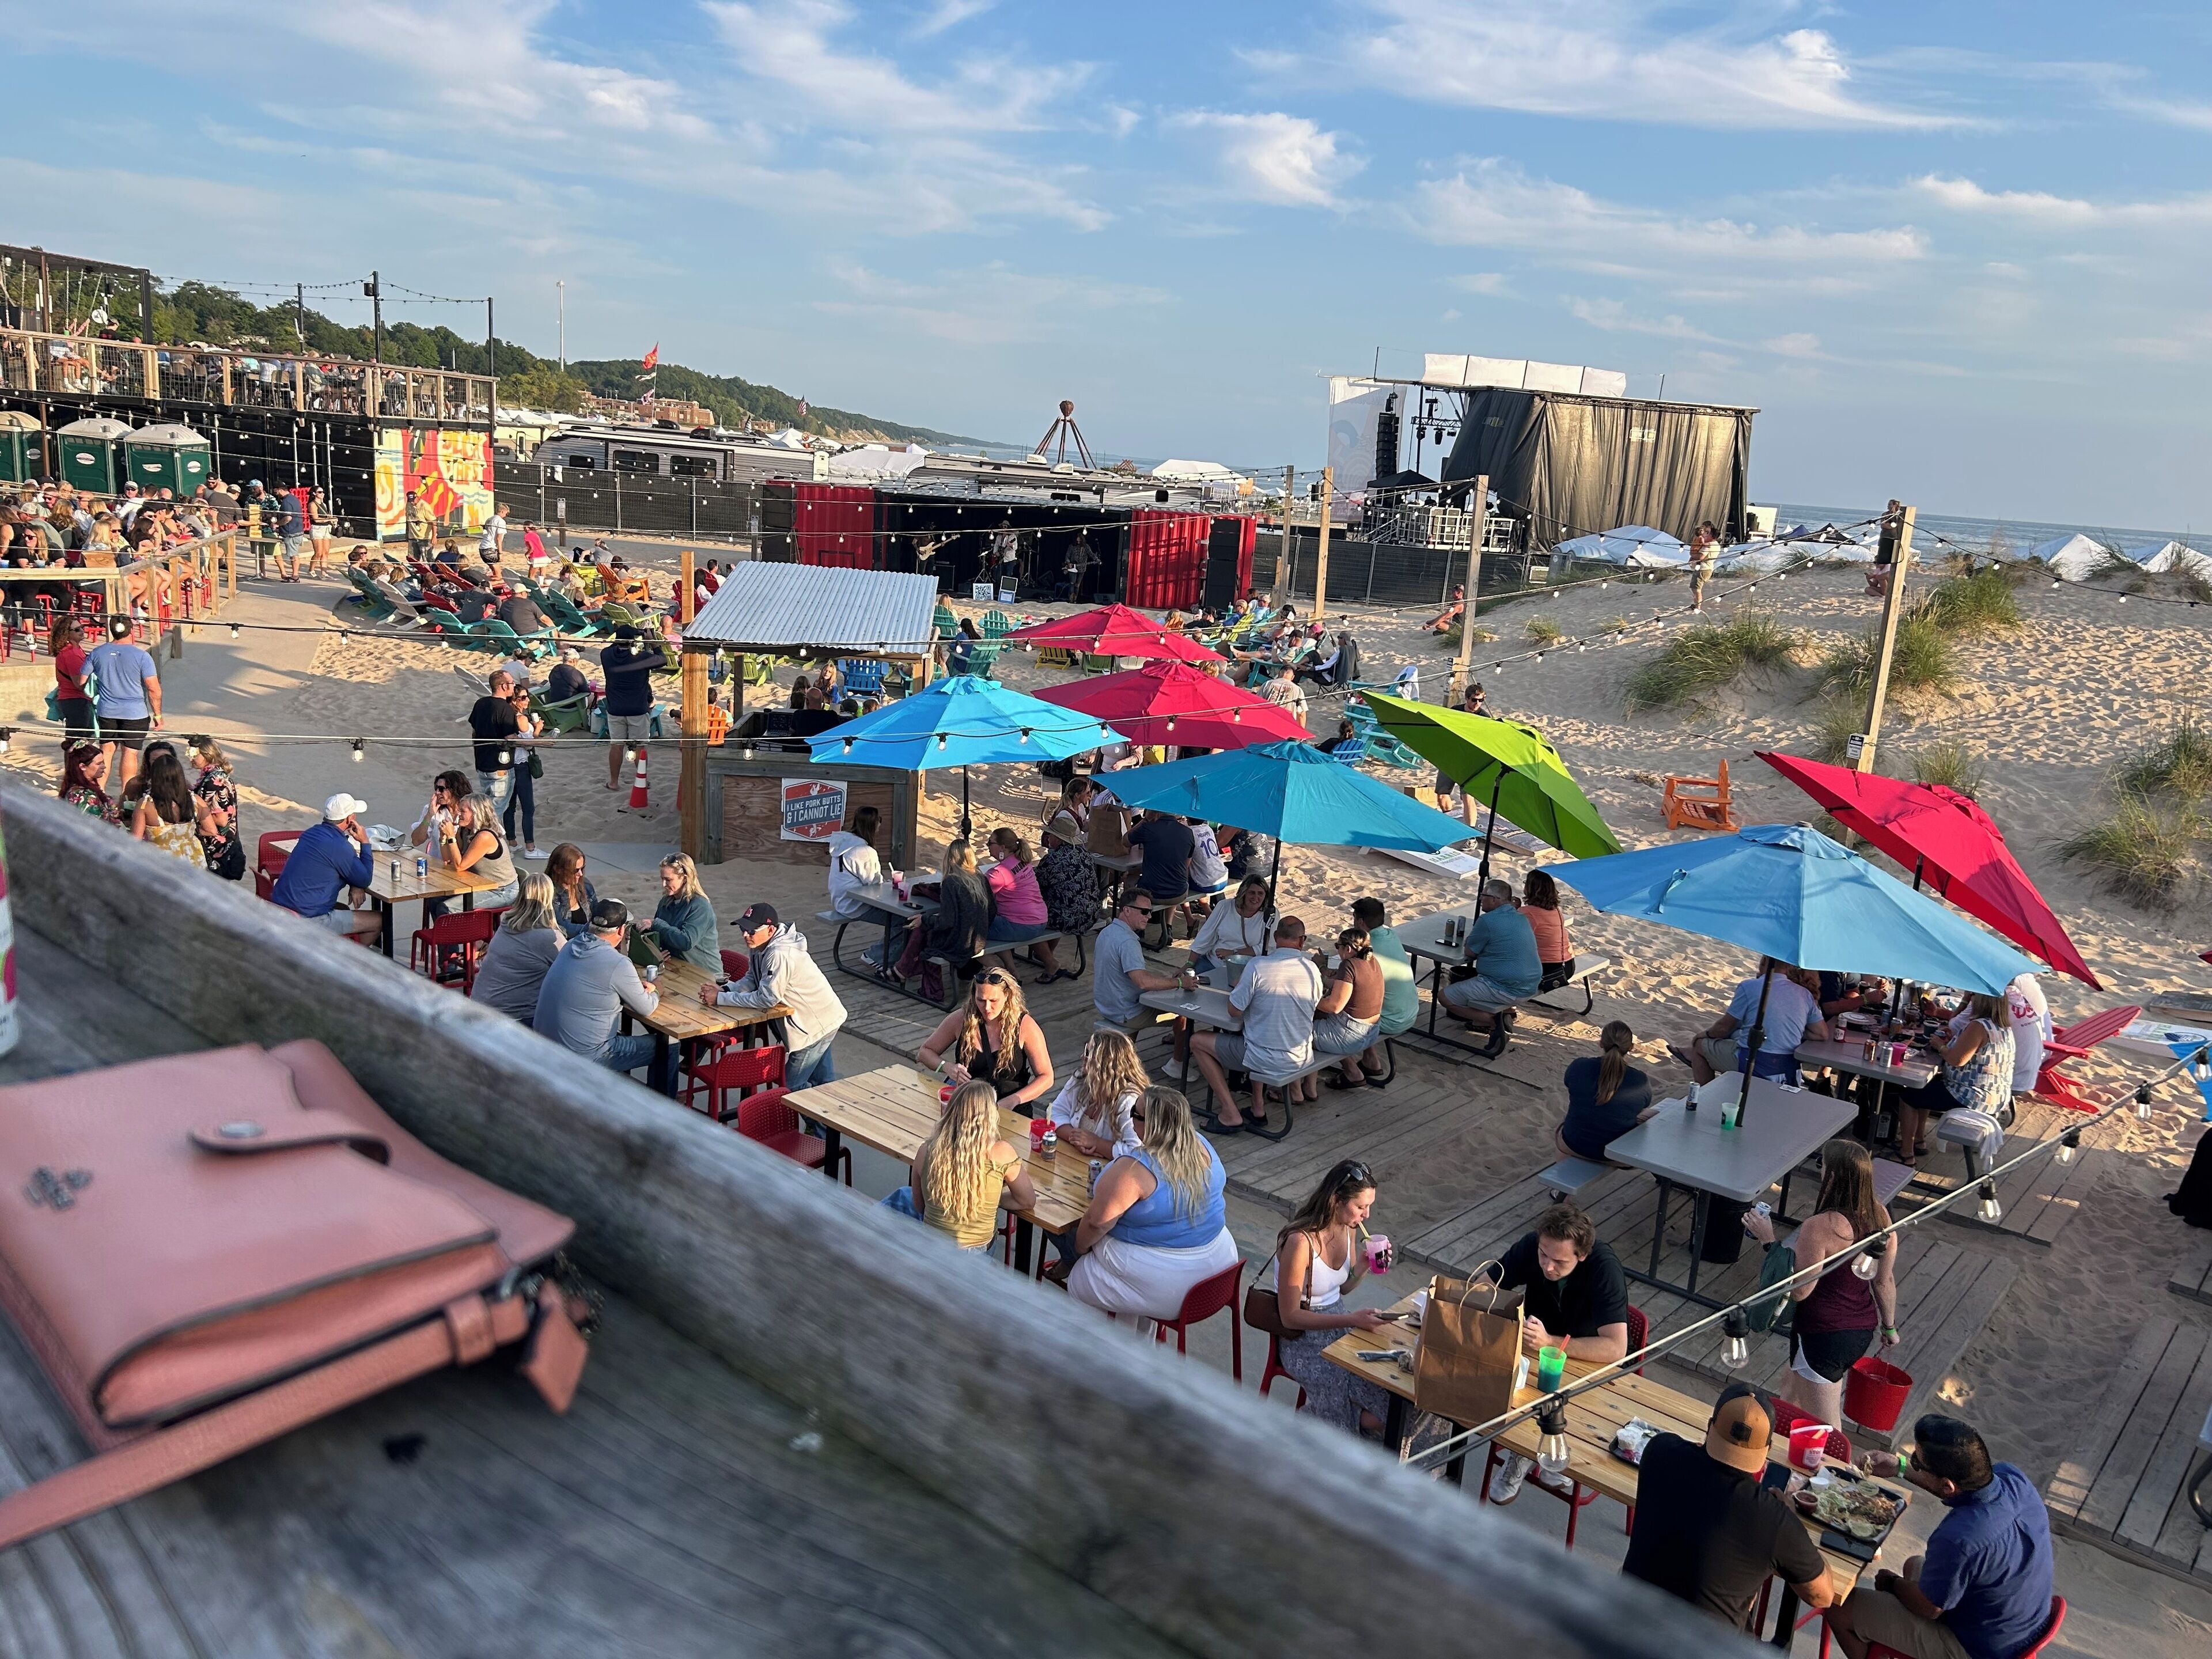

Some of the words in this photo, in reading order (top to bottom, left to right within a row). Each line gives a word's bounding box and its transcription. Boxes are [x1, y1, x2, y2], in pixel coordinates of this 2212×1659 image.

[790, 801, 804, 810] LIKE
[805, 798, 821, 808] PORK
[822, 795, 841, 805] BUTTS
[787, 812, 793, 824] &
[794, 810, 797, 822] I
[798, 805, 829, 821] CANNOT
[830, 804, 842, 816] LIE
[1200, 838, 1219, 858] 10
[1011, 861, 1028, 875] VOLUN
